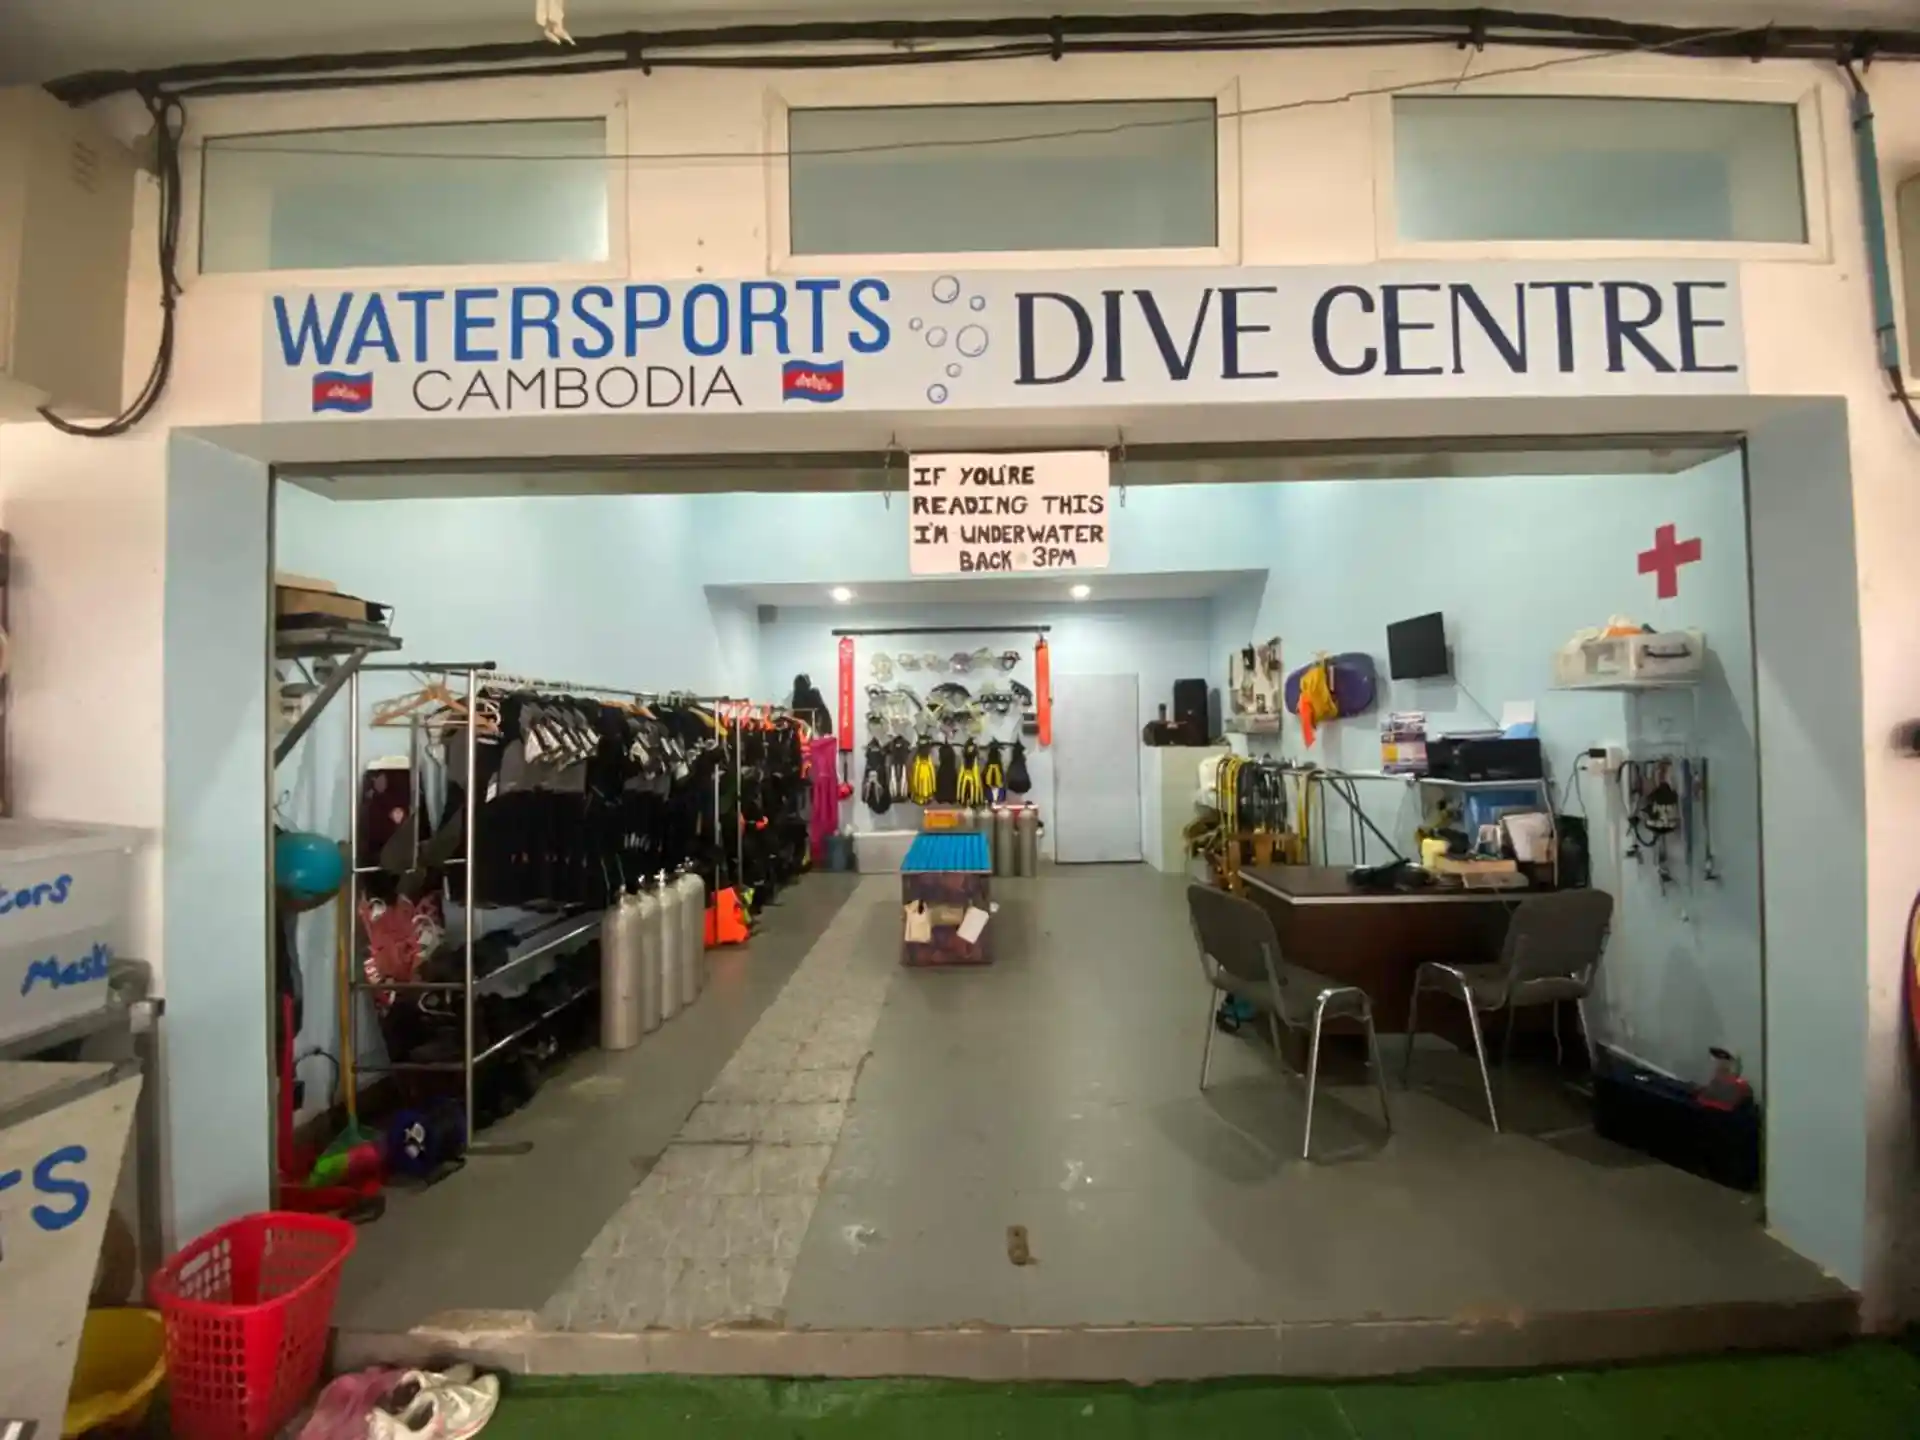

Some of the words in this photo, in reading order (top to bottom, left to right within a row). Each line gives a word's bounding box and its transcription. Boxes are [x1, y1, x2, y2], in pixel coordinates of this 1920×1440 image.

[273, 279, 890, 366] WATERSPORTS
[1014, 287, 1279, 385] DIVE
[1312, 281, 1739, 376] CENTRE
[412, 365, 743, 412] CAMBODIA
[913, 467, 946, 486] IF
[959, 464, 1035, 486] YOU'RE
[912, 496, 1028, 515] READING
[1041, 495, 1104, 515] THIS
[914, 522, 949, 544] I'M
[960, 524, 1104, 544] UNDERWATER
[959, 550, 1012, 572] BACK
[1032, 546, 1077, 568] 3PM
